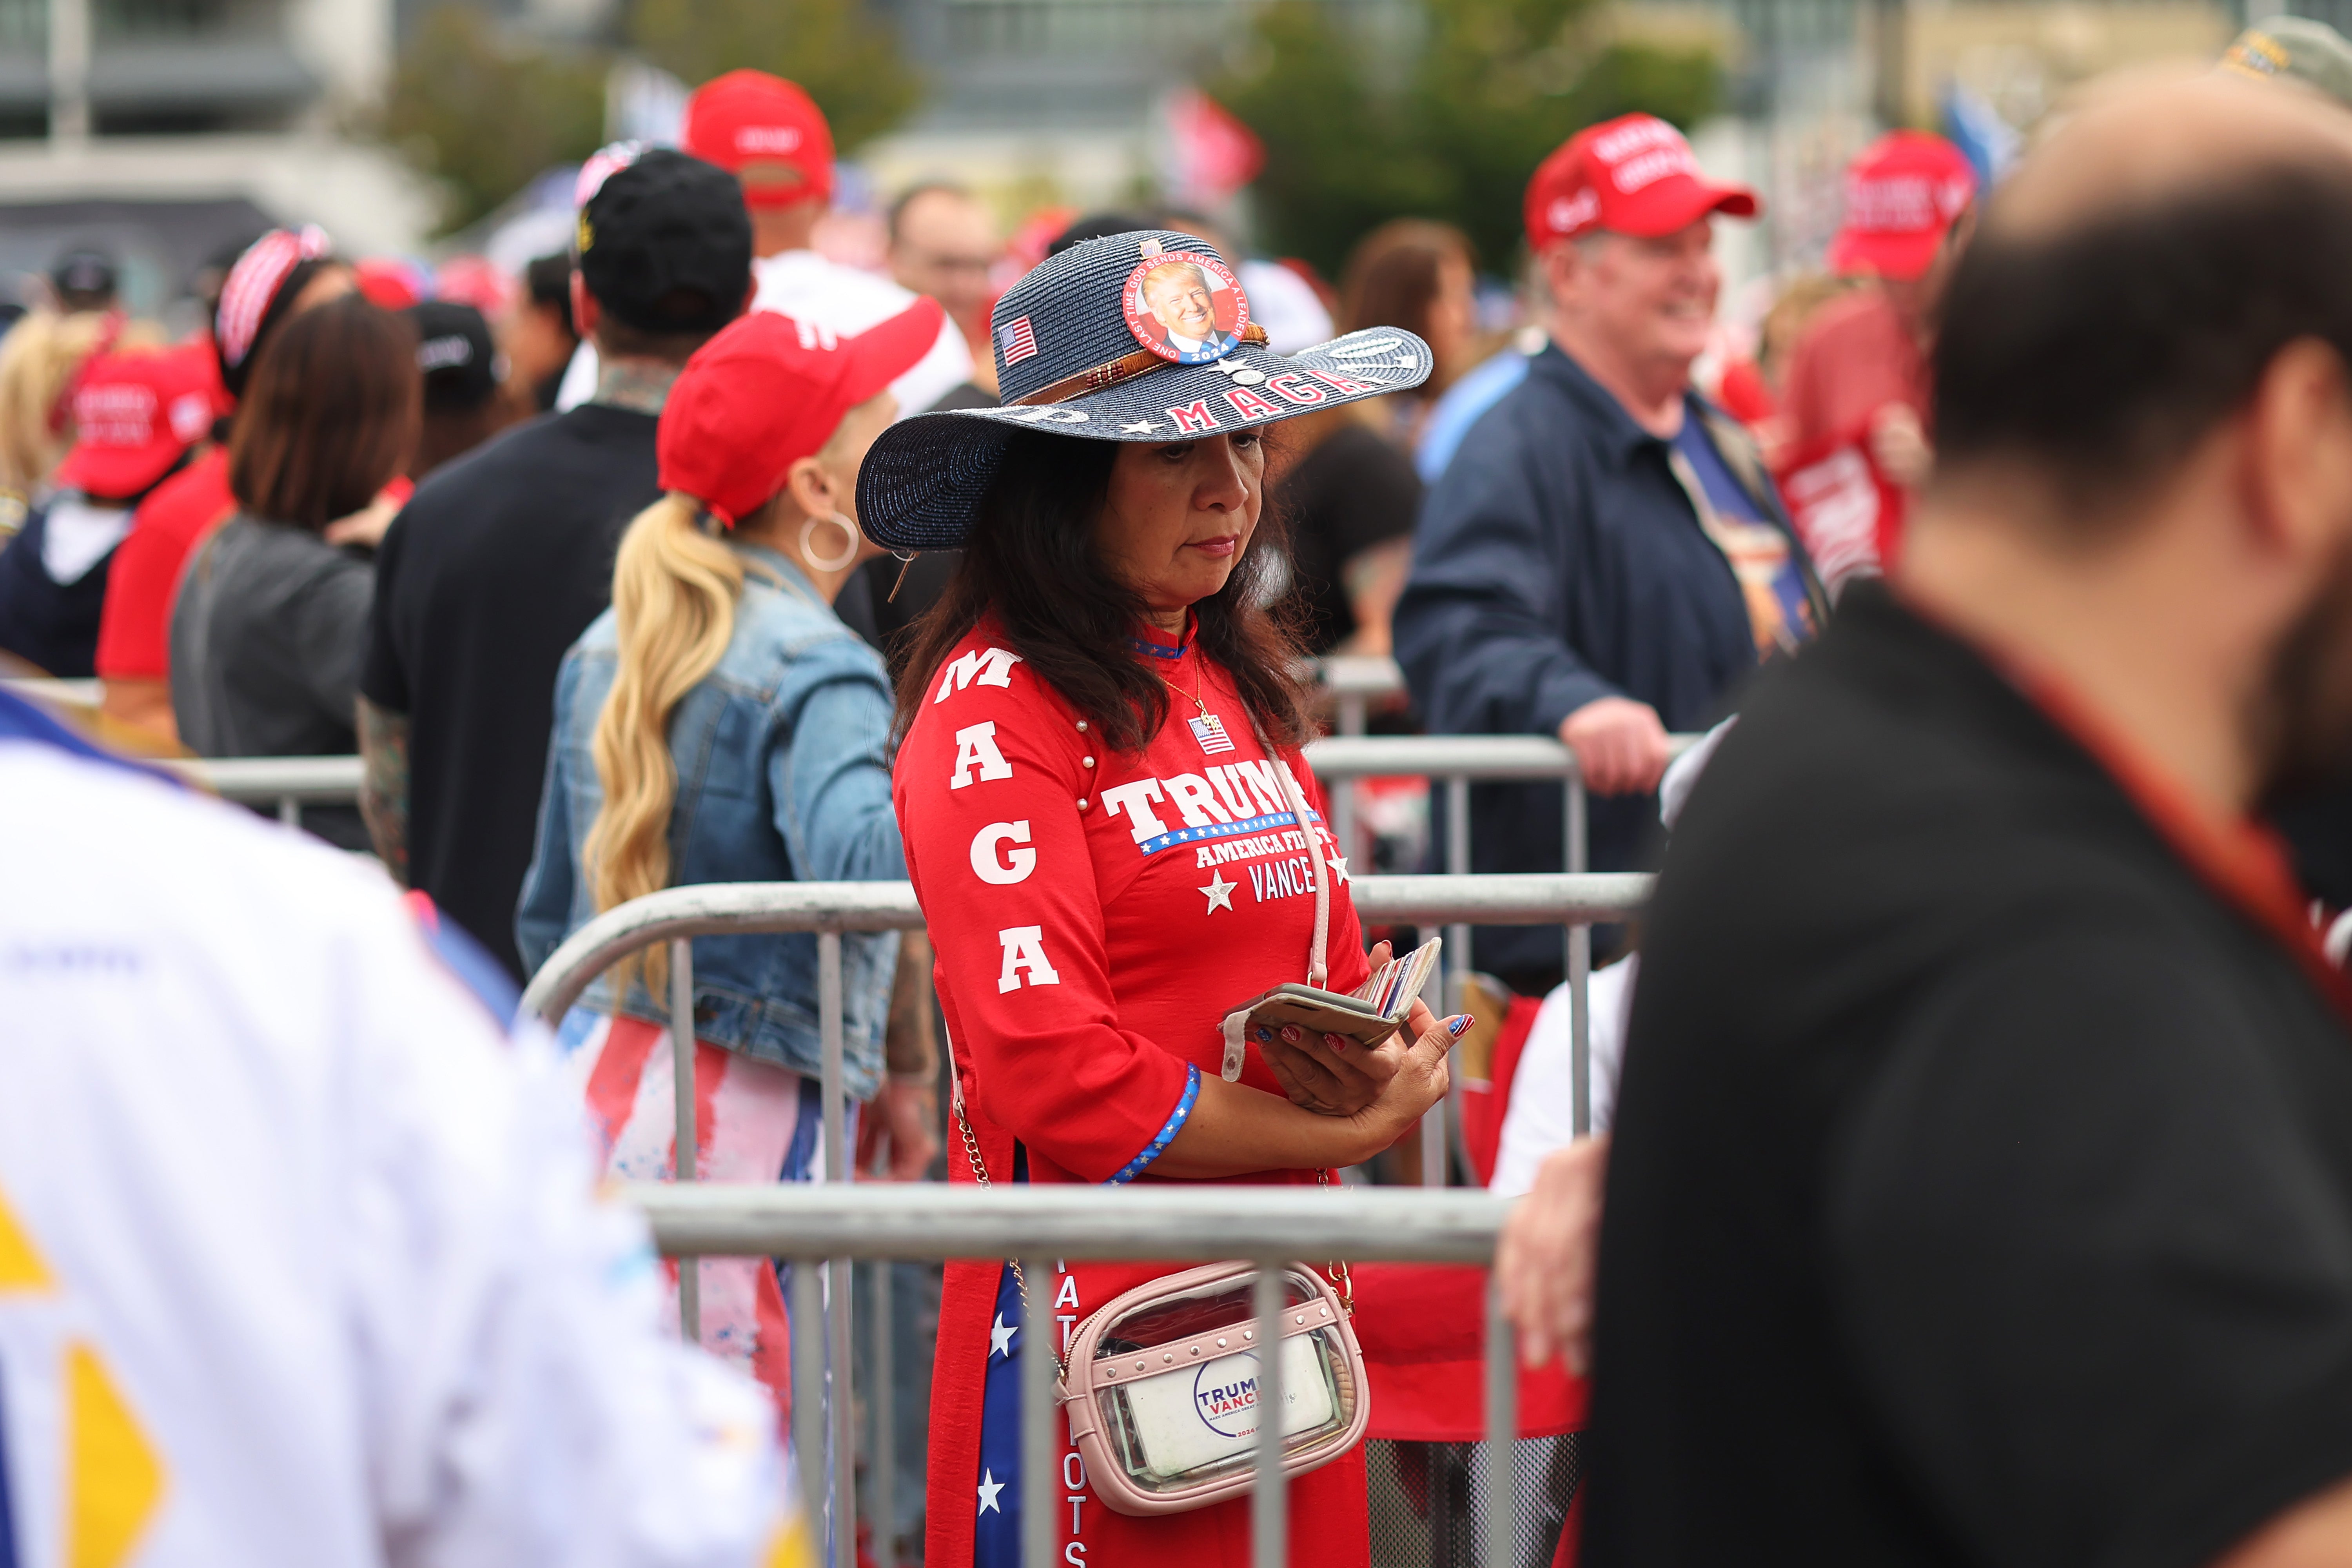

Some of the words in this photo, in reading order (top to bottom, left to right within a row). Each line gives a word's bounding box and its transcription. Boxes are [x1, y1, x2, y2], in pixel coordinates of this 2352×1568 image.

[1146, 253, 1183, 269] SENDS
[1187, 254, 1234, 285] AMERICA
[1129, 268, 1147, 288] GOD
[1126, 291, 1136, 316] TIME
[1233, 297, 1247, 337] LEADER
[1130, 320, 1152, 344] LAST
[1152, 342, 1177, 358] ONE
[1191, 343, 1229, 361] 2024
[1167, 370, 1376, 434] MAGA
[934, 648, 1060, 995] MAGA
[1196, 834, 1286, 869] AMERICA
[1248, 856, 1316, 902] VANCE
[1238, 1428, 1255, 1437] 2024
